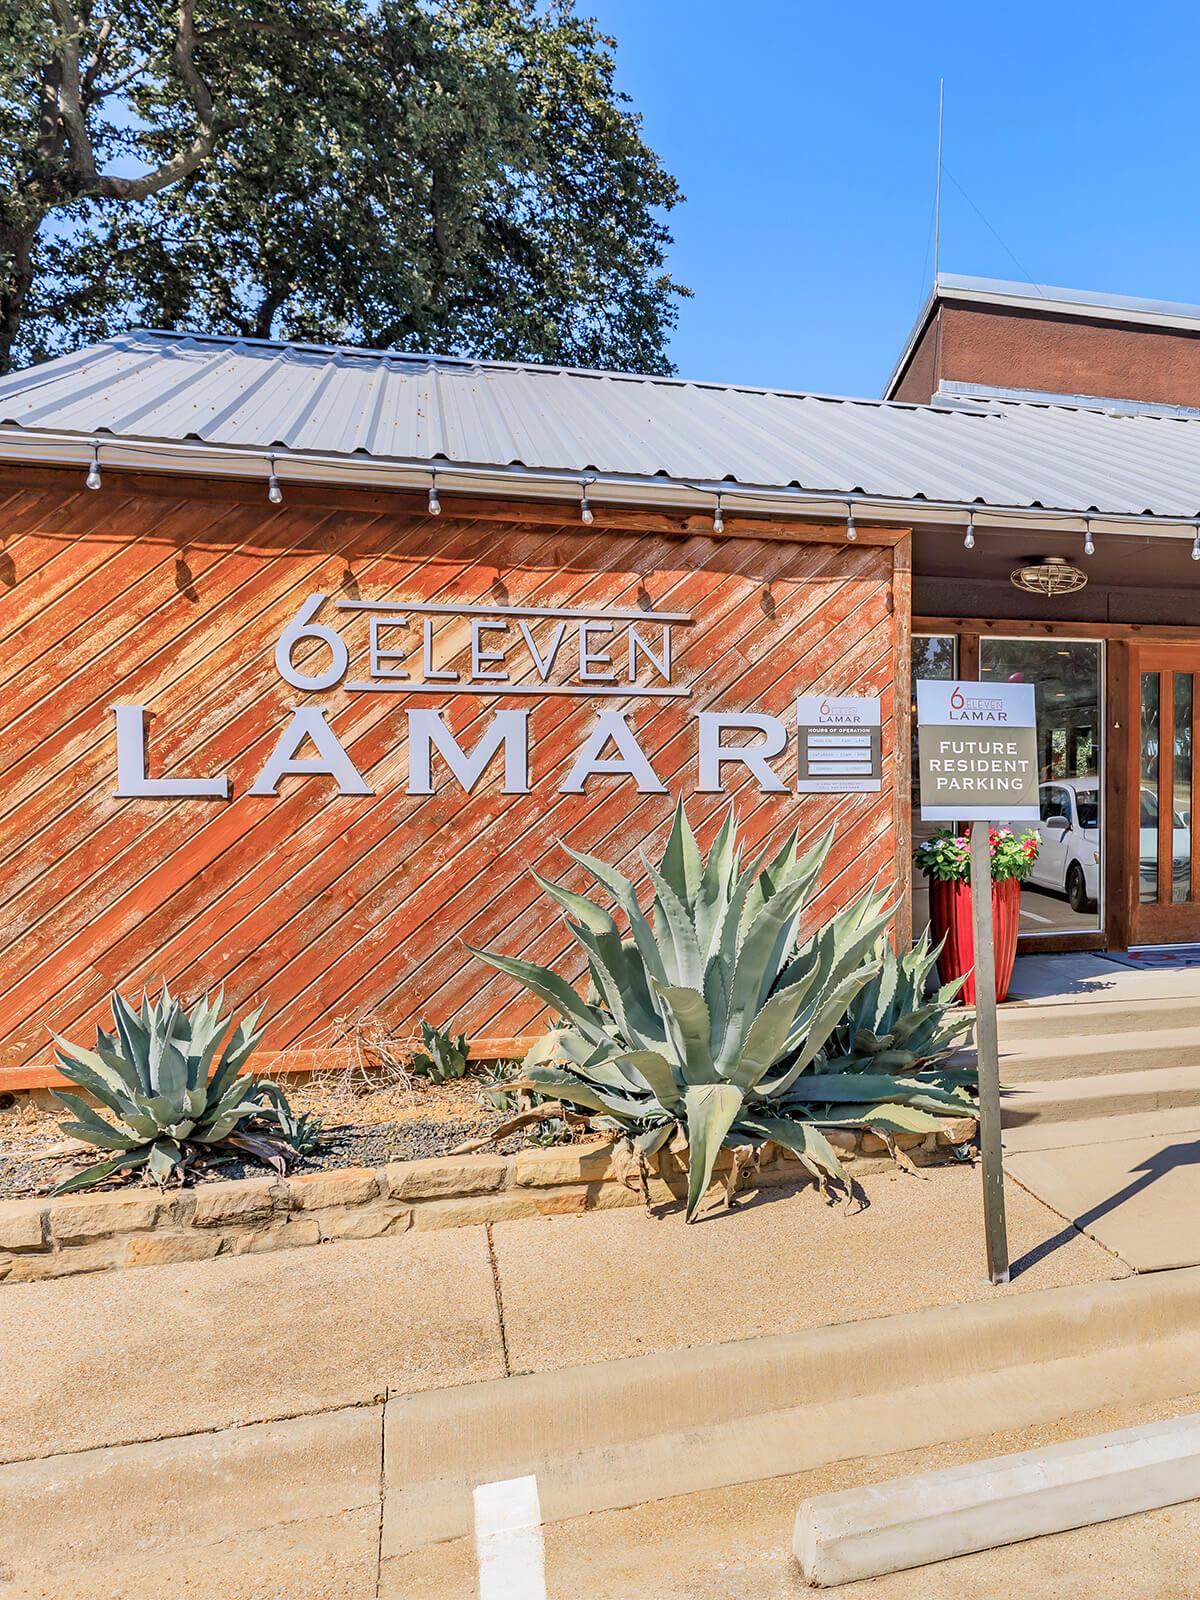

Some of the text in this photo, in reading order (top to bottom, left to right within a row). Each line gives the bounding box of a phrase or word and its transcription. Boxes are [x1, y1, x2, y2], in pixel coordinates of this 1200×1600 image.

[274, 593, 674, 692] 6 ELEVEN
[950, 686, 1003, 710] 6 ELEVEN
[949, 711, 1008, 721] LAMAR
[112, 704, 794, 799] LAMAR
[939, 741, 1018, 755] FUTURE
[929, 759, 1029, 773] RESIDENT
[936, 777, 1024, 790] PARKING
